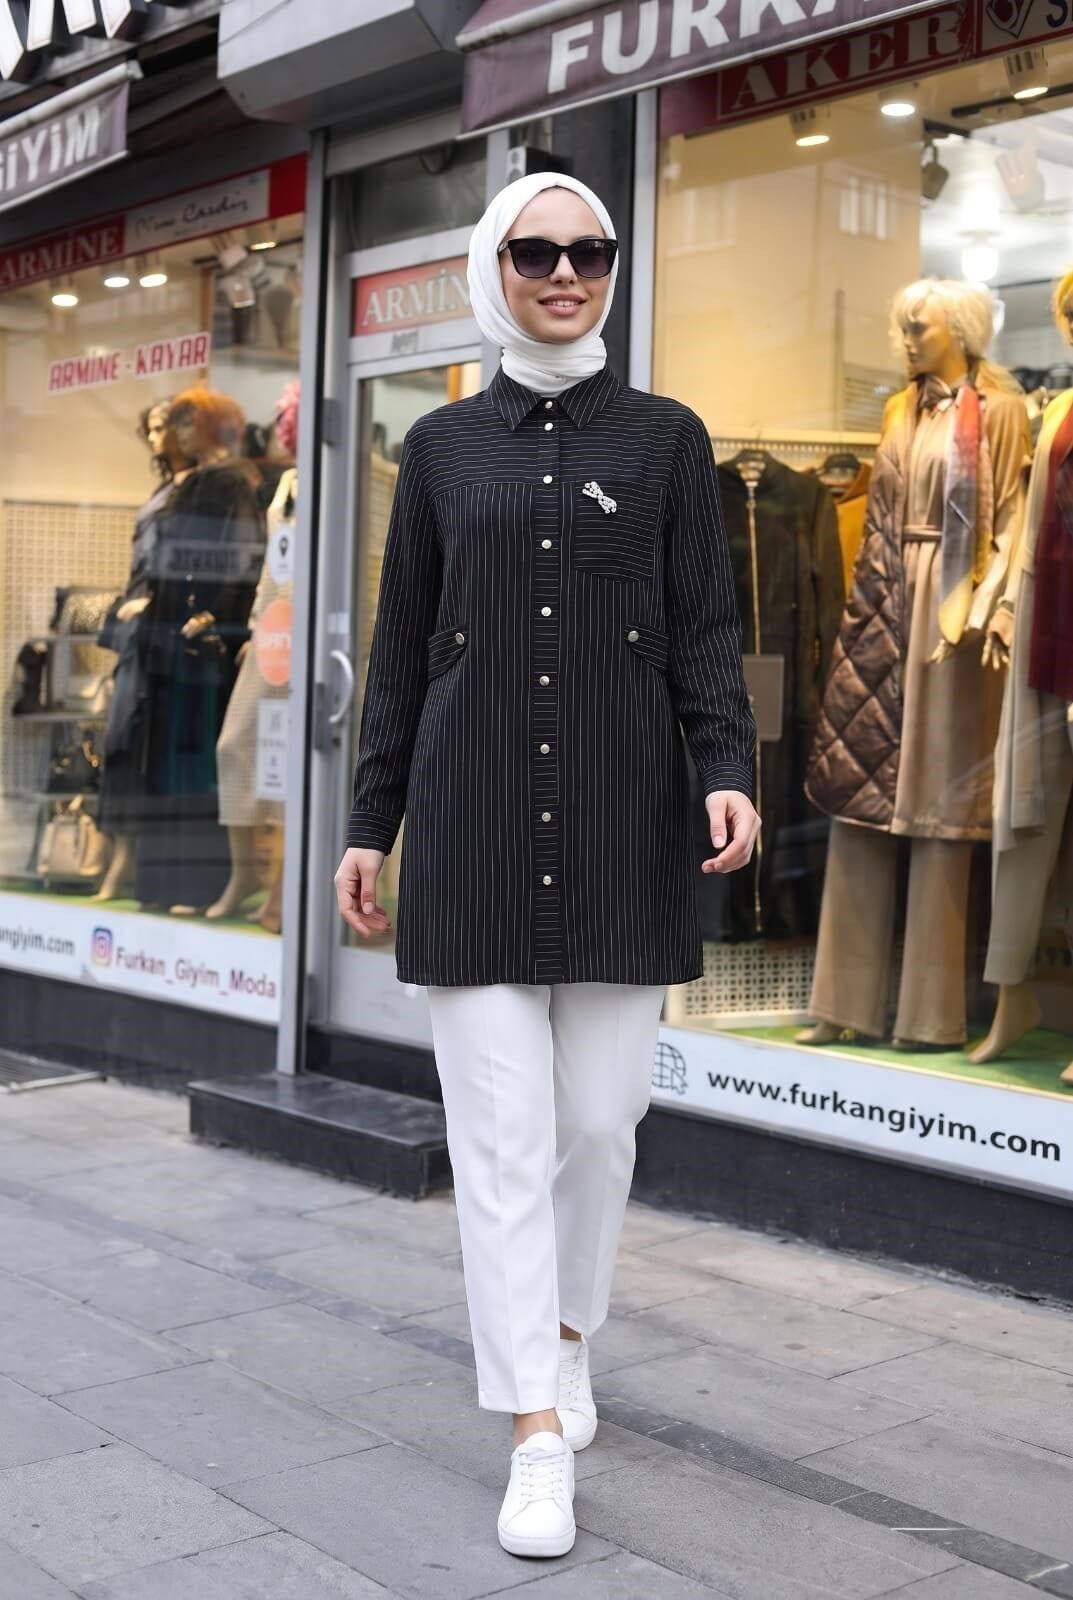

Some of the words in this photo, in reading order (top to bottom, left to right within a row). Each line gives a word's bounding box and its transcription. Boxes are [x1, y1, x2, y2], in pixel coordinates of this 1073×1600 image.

[547, 0, 868, 94] FURK
[731, 10, 962, 110] AKER
[0, 103, 100, 191] İYİM
[136, 335, 207, 376] KAYAR
[0, 926, 75, 955] ngiyim.com
[115, 946, 277, 999] Furkan_Giyim_Moda
[706, 1069, 1062, 1162] www.furkangiyim.com
